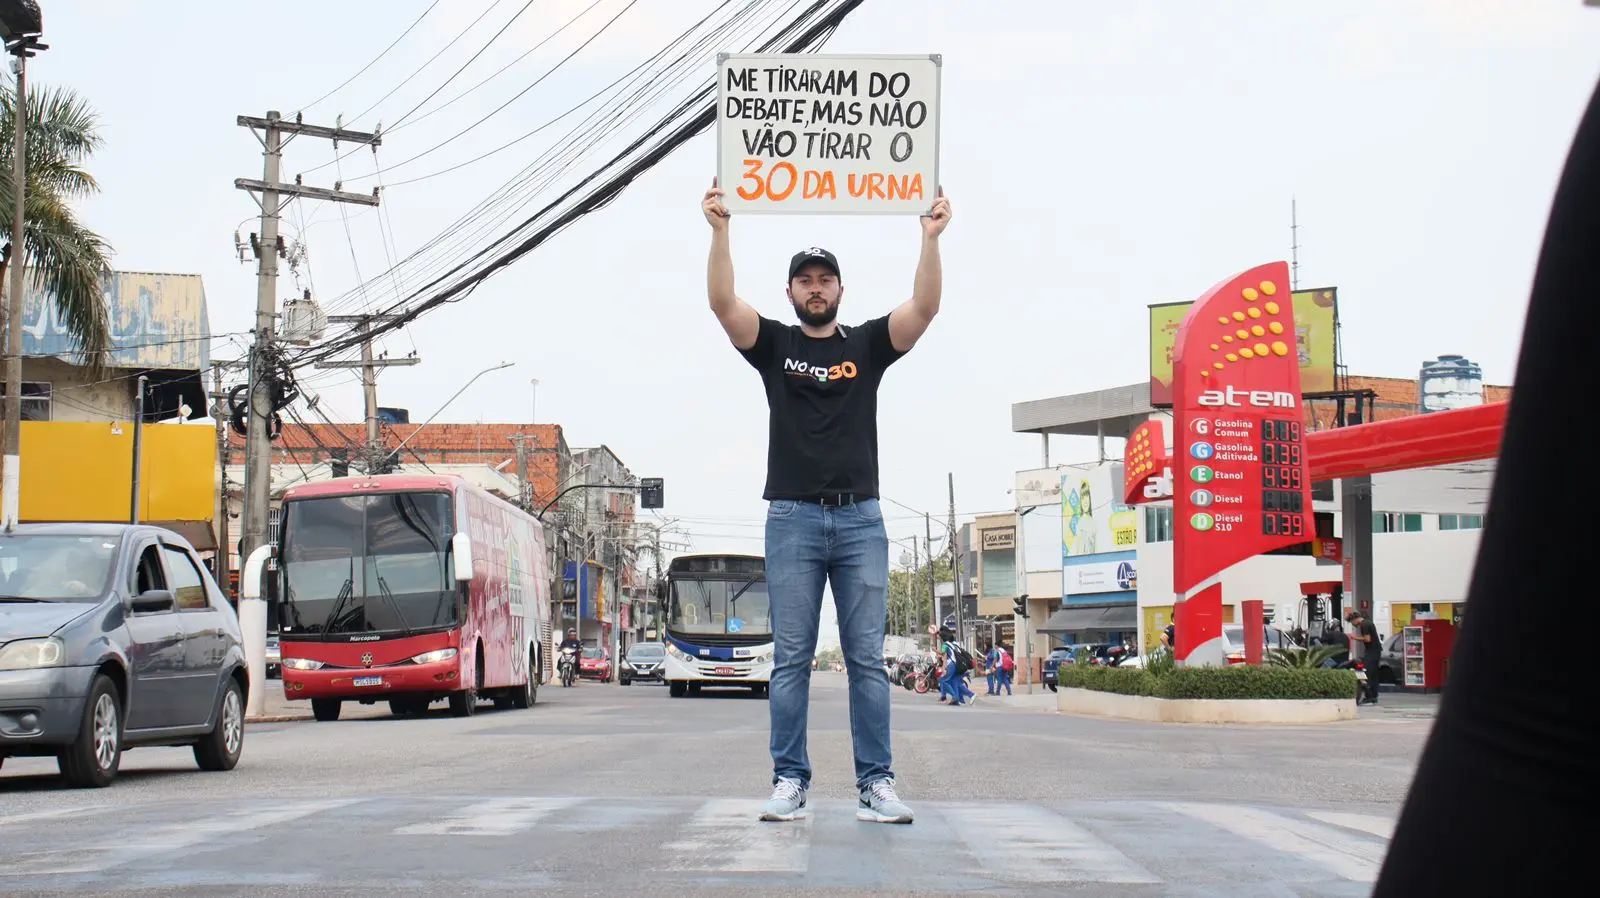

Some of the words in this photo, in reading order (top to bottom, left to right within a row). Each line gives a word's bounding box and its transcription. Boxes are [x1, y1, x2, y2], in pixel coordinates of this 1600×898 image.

[727, 68, 758, 92] ME
[763, 65, 857, 96] TIRARAM
[869, 72, 910, 99] DO
[870, 99, 927, 129] NÃO
[742, 123, 797, 157] VÃO
[803, 128, 872, 160] TIRAR
[890, 132, 913, 162] O
[736, 159, 798, 201] 30
[802, 170, 836, 199] DA
[848, 173, 923, 200] URNA
[1198, 385, 1295, 408] atem
[1214, 419, 1253, 428] Gasolina
[1214, 429, 1249, 437] Comum
[1265, 420, 1300, 442] 7.19
[1214, 443, 1253, 452] Gasolina
[1215, 452, 1258, 461] Aditivada
[1265, 443, 1300, 465] 7.39
[1214, 471, 1244, 479] Etanol
[1265, 467, 1300, 489] 4.99
[1215, 514, 1243, 522] Diesel
[1265, 514, 1302, 536] 7.39
